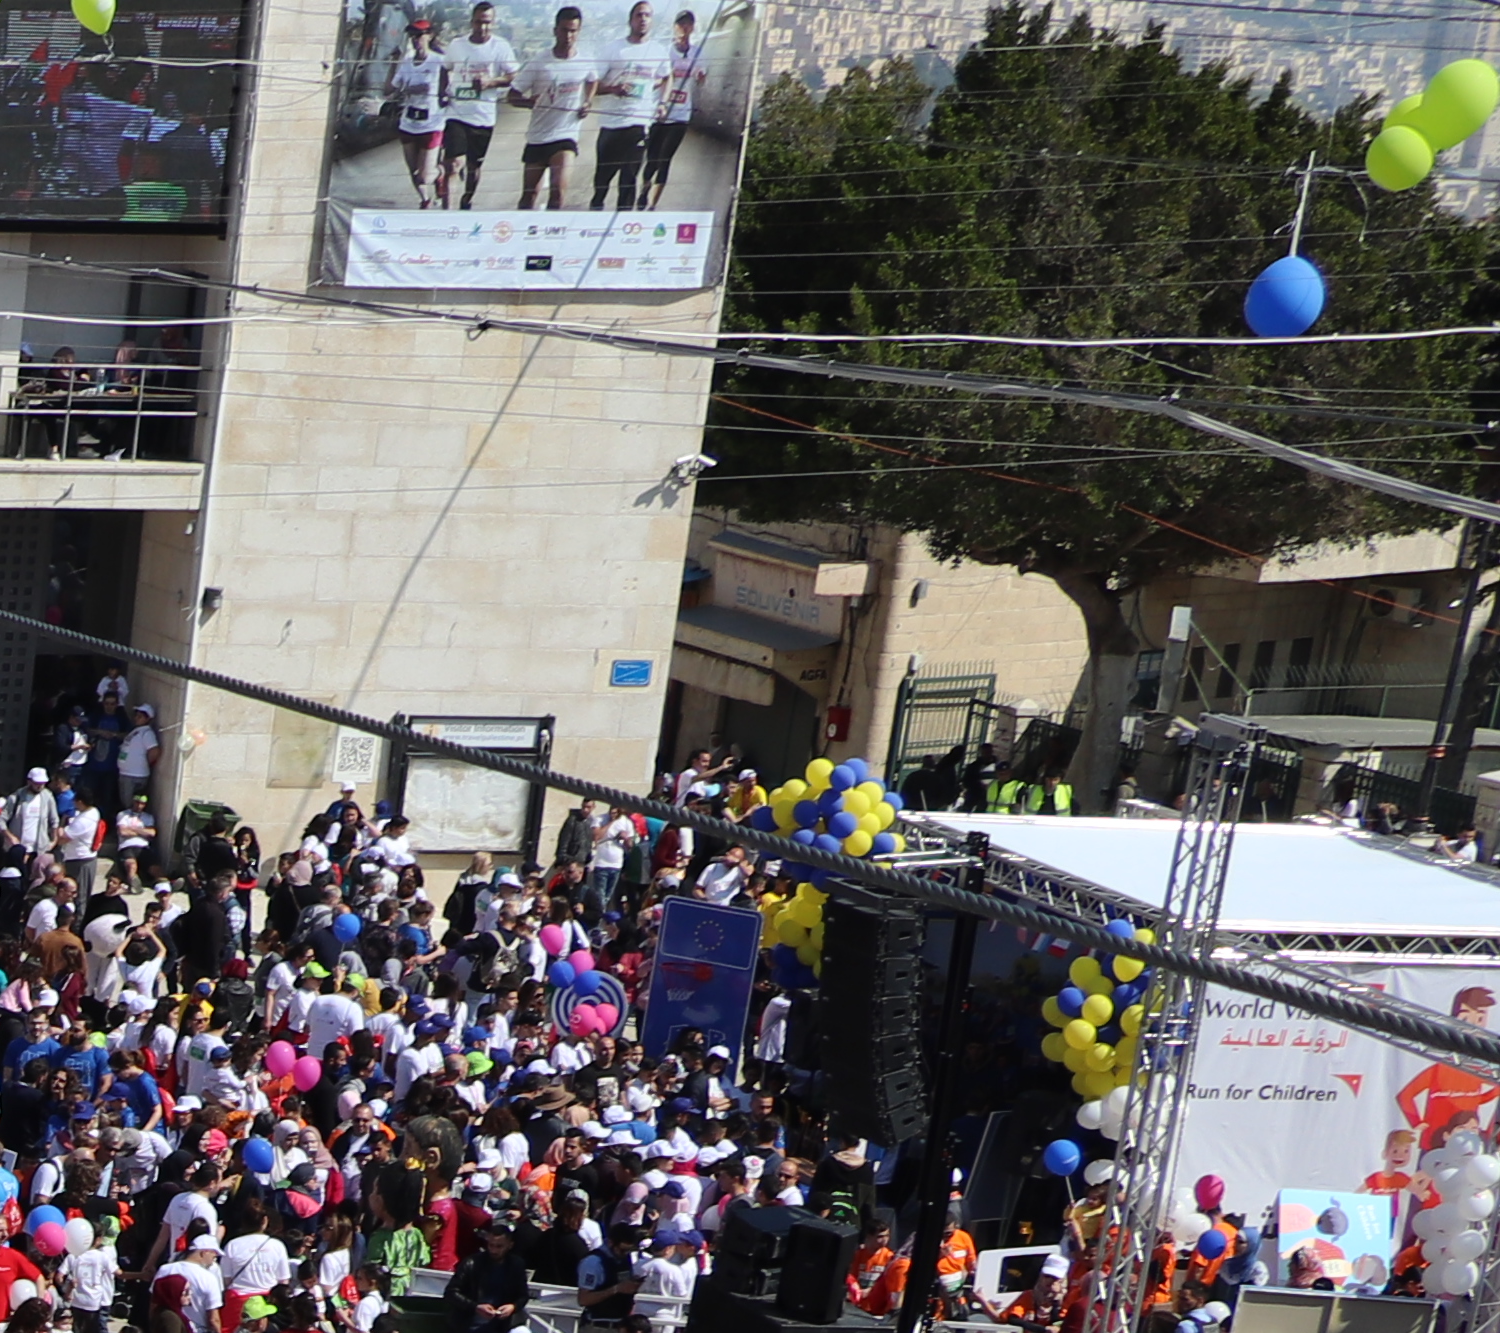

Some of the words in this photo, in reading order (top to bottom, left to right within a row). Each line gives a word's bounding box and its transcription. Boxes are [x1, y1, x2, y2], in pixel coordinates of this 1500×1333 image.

[800, 668, 828, 682] AGFA
[1204, 999, 1276, 1020] World
[1219, 1028, 1287, 1052] العالمية
[1291, 1029, 1348, 1054] الرؤية
[1186, 1084, 1220, 1101] Run
[1226, 1084, 1252, 1101] for
[1258, 1084, 1338, 1102] Children
